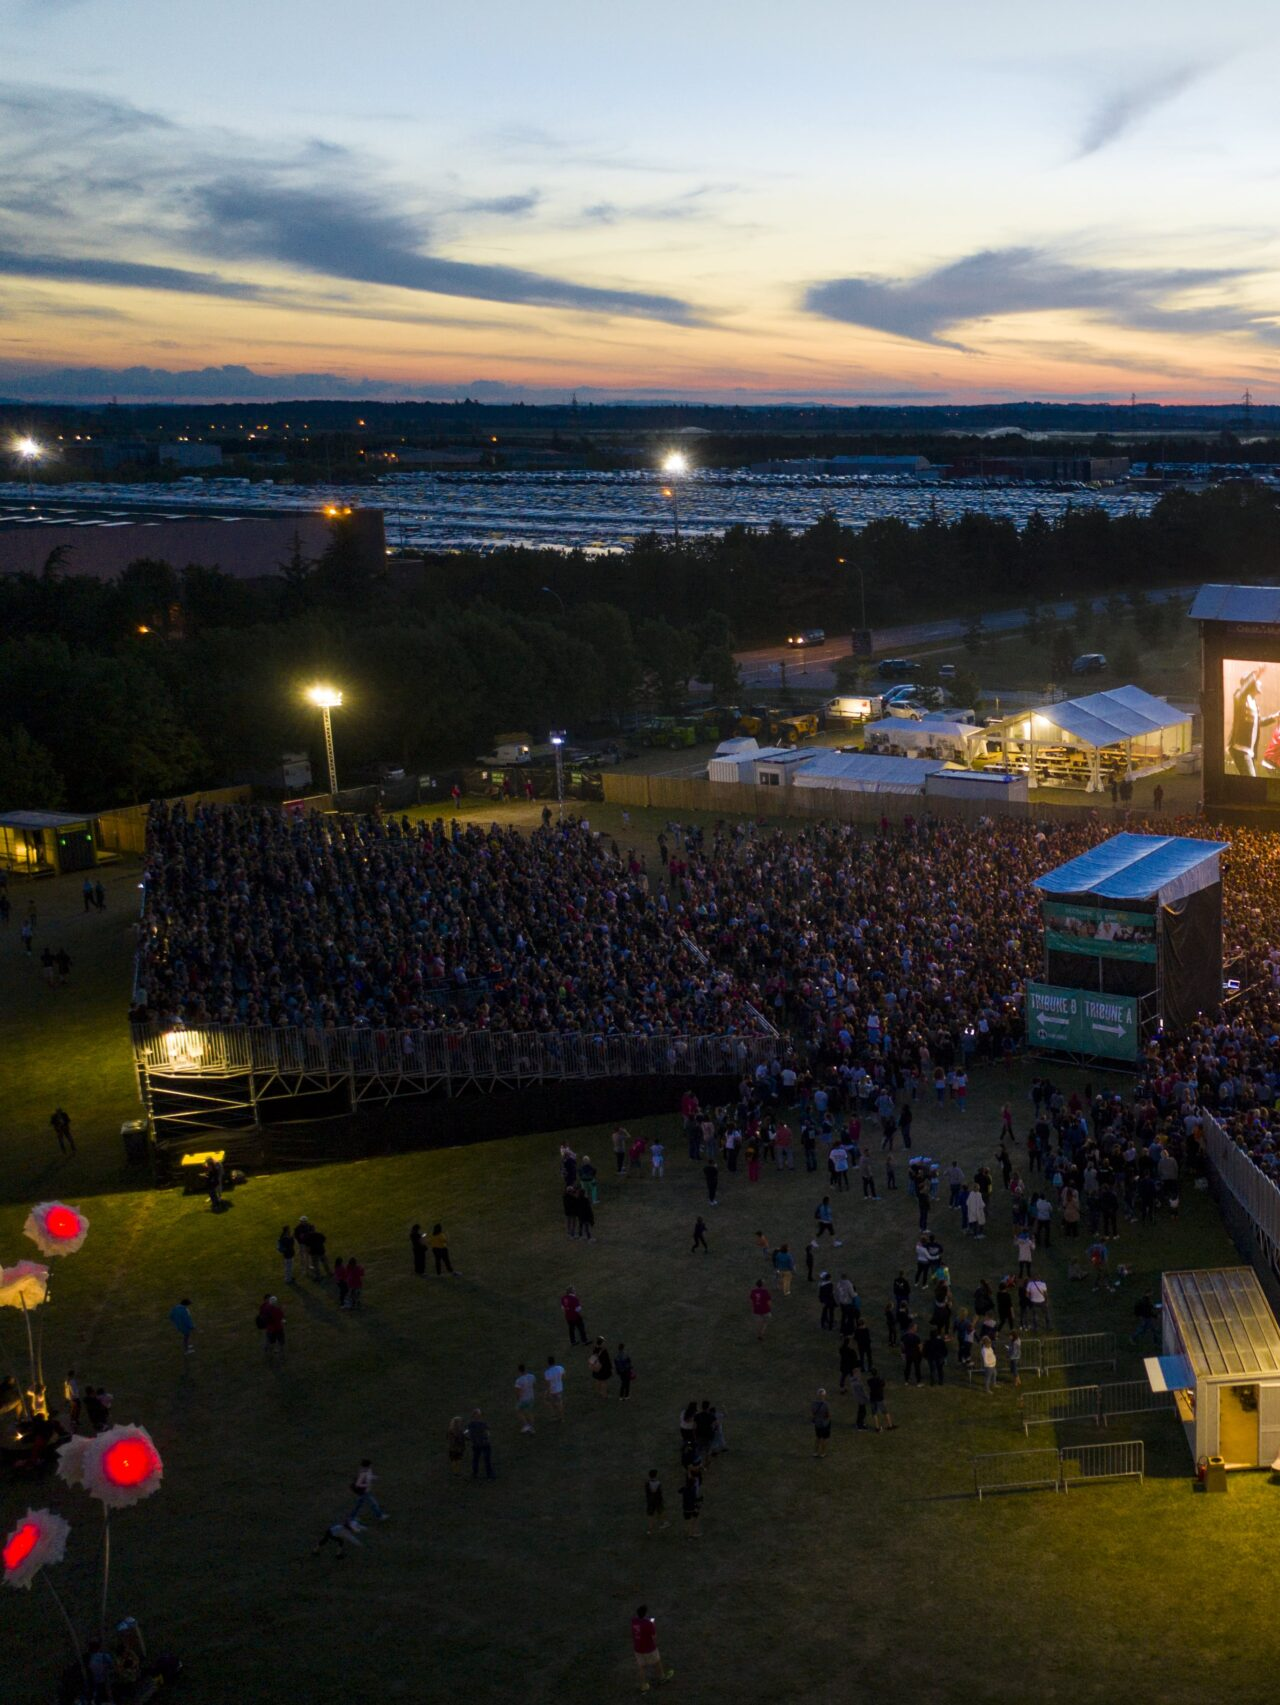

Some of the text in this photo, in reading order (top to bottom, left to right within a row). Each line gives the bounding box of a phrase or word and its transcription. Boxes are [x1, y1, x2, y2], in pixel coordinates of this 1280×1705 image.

[1030, 993, 1068, 1014] TRIBUNE
[1084, 1001, 1133, 1025] TRIBUNE A
